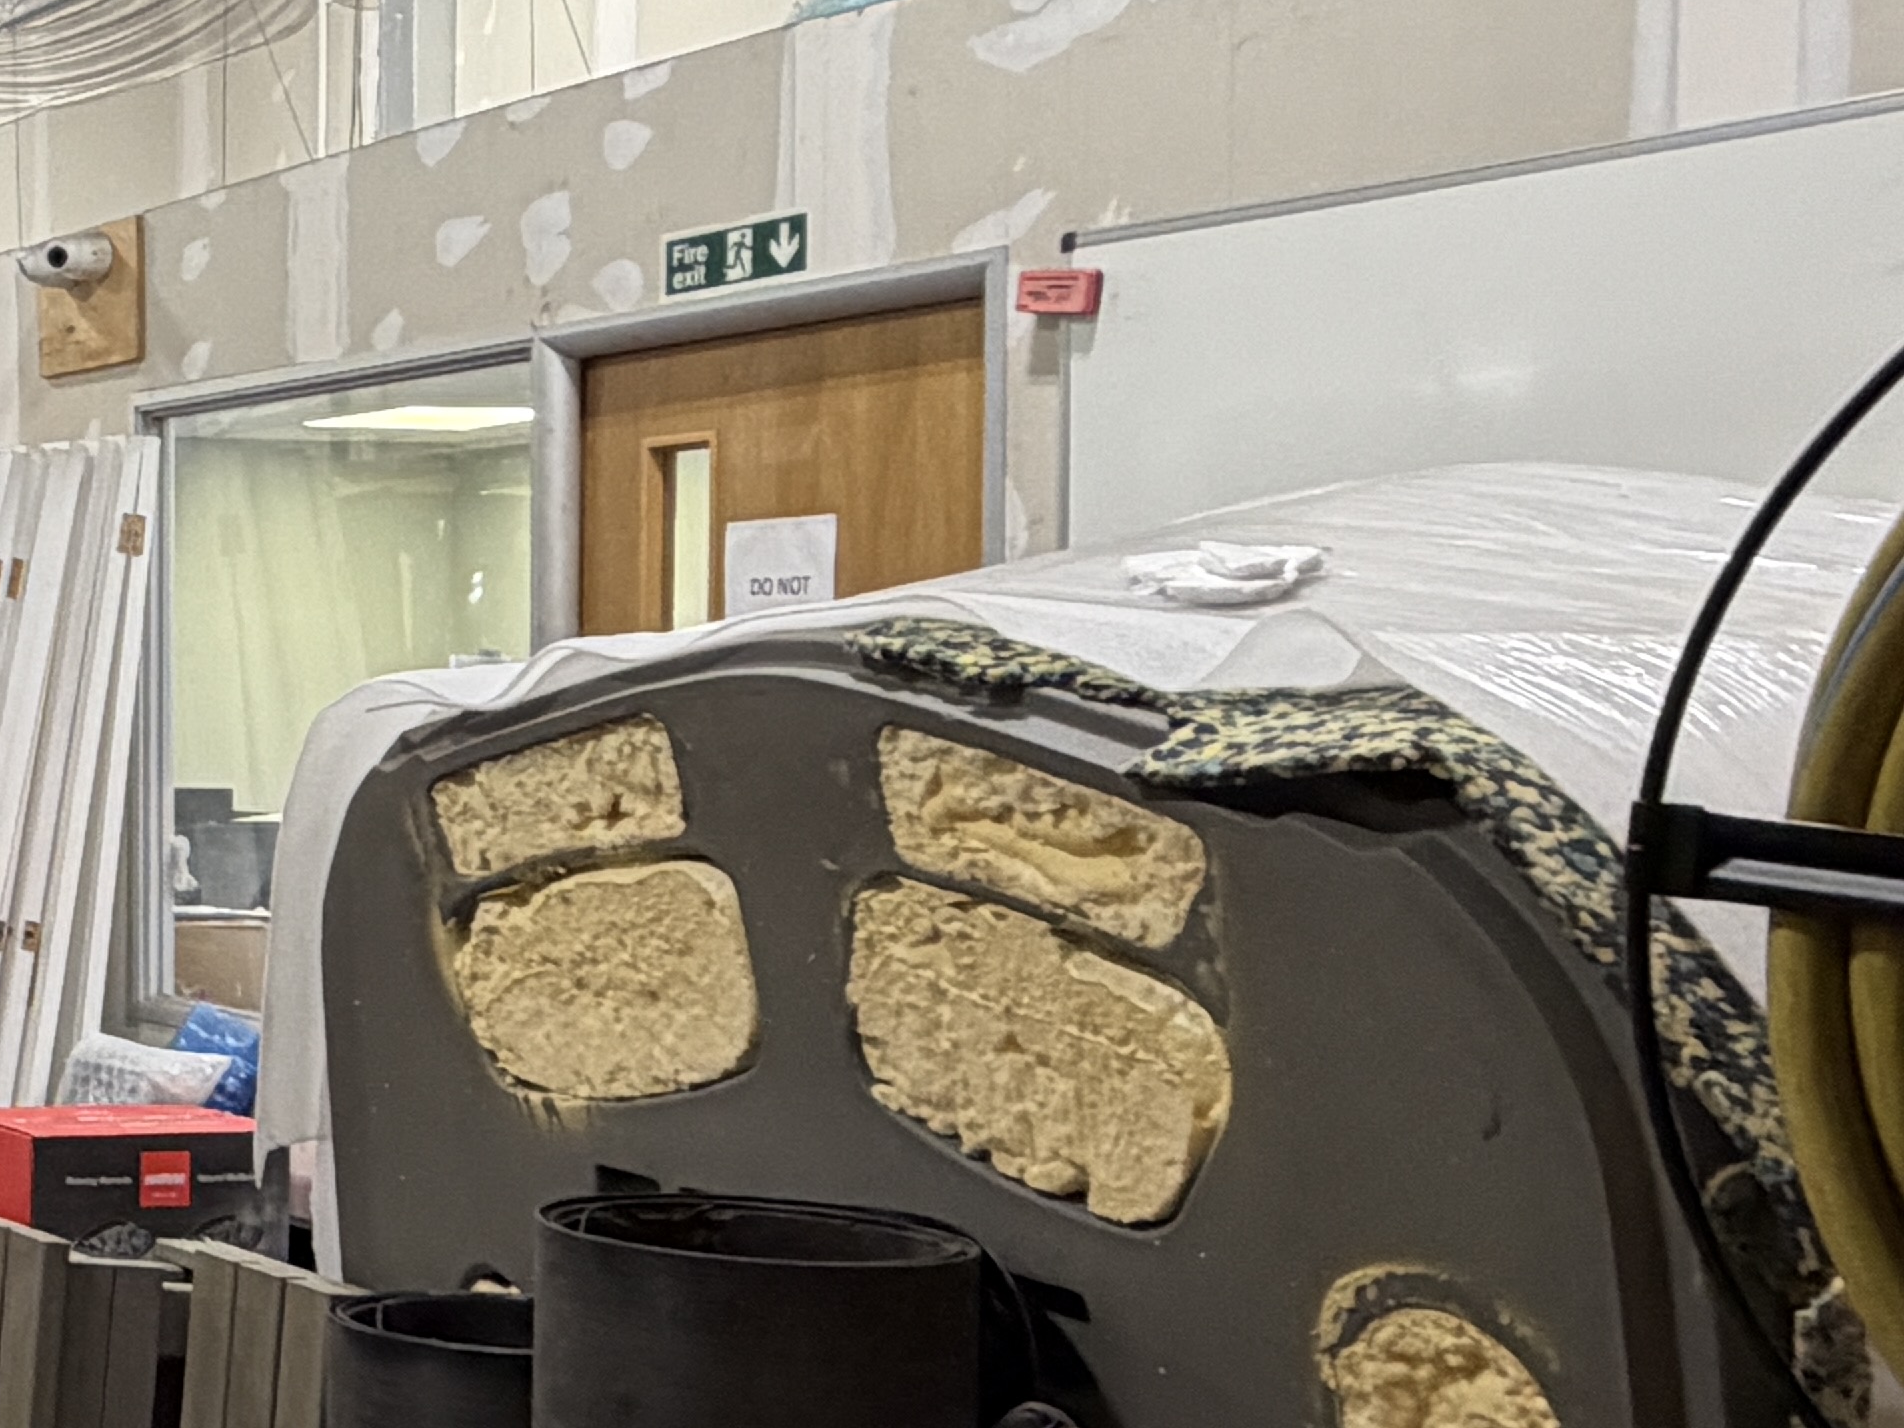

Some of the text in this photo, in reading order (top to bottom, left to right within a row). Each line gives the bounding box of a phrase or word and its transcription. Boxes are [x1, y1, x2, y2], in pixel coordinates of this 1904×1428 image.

[672, 244, 709, 267] Fire
[672, 264, 707, 289] exit
[749, 575, 811, 596] DO NOT
